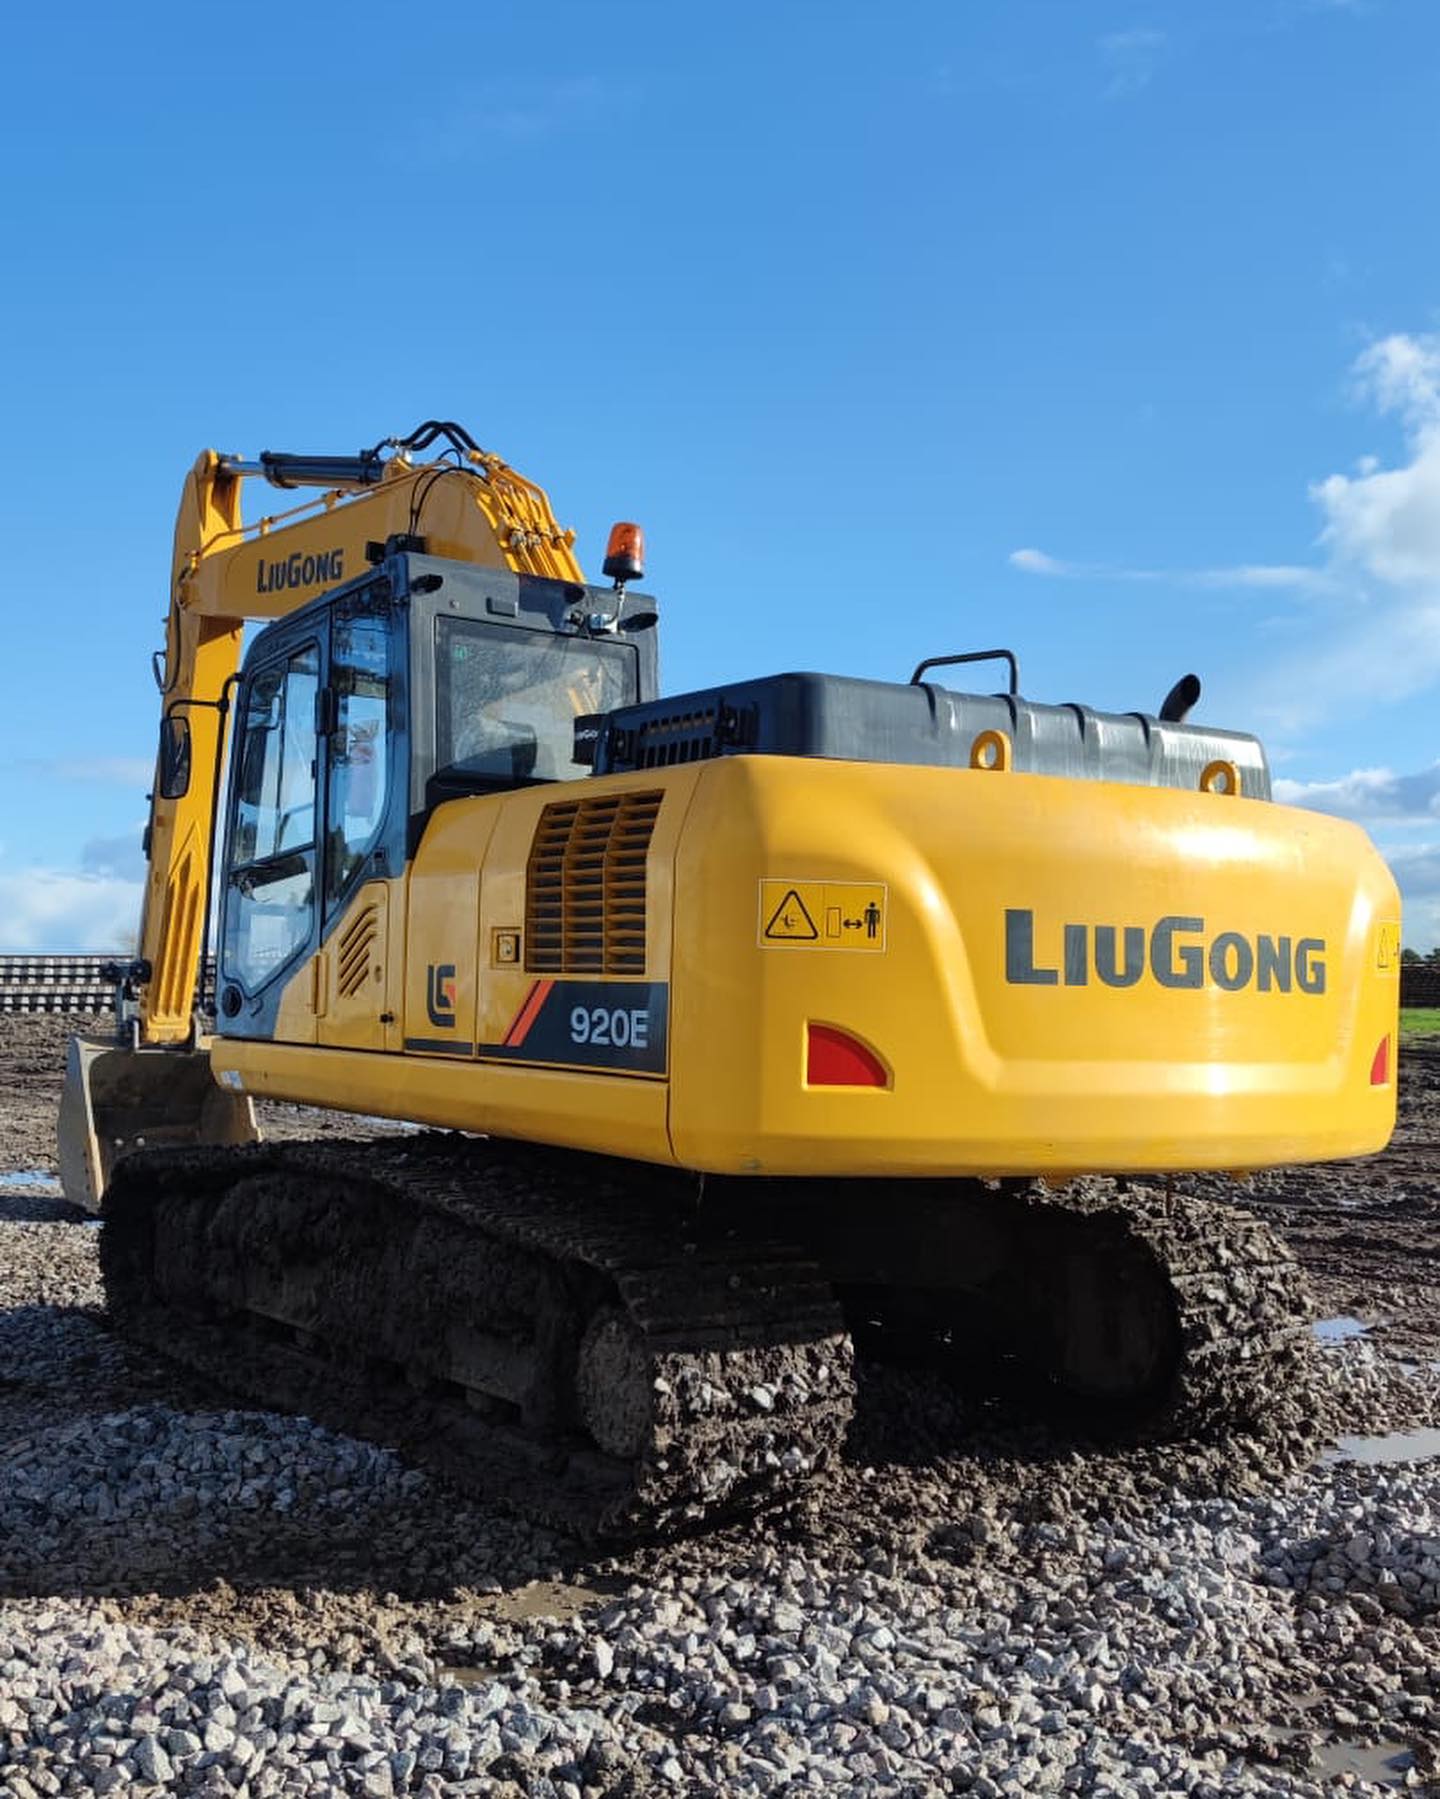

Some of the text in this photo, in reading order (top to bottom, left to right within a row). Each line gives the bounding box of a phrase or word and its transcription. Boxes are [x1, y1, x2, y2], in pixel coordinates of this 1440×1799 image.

[257, 548, 344, 593] LIUGONG
[1005, 908, 1326, 995] LIUGONG
[570, 1006, 649, 1048] 920E
